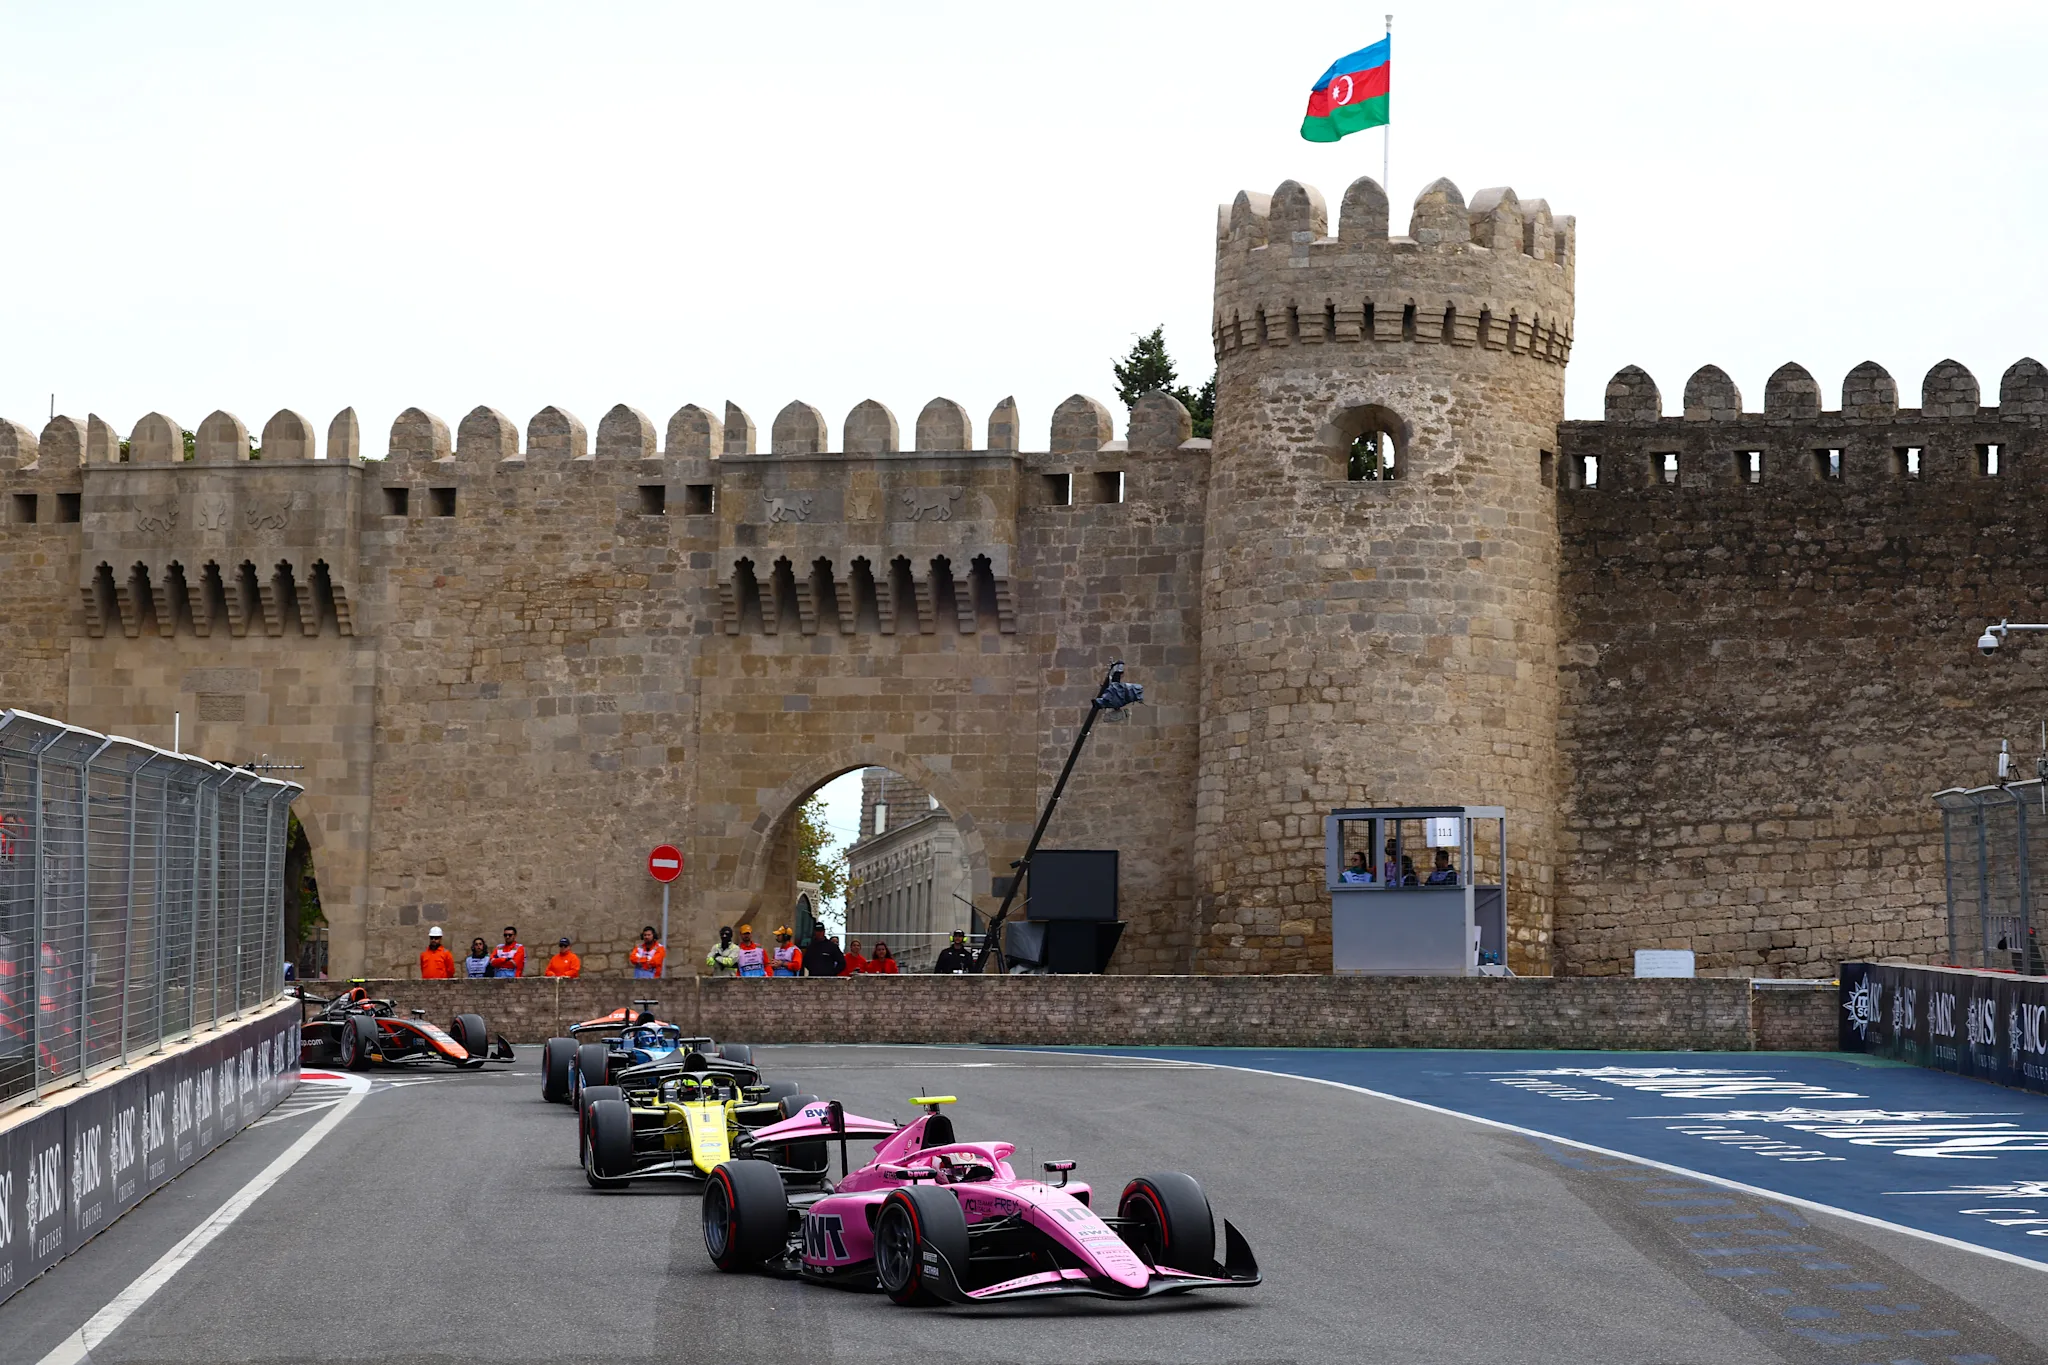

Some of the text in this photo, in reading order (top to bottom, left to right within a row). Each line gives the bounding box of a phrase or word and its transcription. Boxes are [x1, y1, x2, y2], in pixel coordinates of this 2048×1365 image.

[1438, 828, 1452, 836] 11.1
[1935, 992, 1956, 1037] MSC
[2022, 1003, 2047, 1055] MSC
[119, 1106, 135, 1172] MSC
[149, 1091, 165, 1152] MSC
[39, 1142, 61, 1222] MSC
[82, 1124, 101, 1196] MSC
[1053, 1207, 1092, 1222] 10
[39, 1226, 61, 1258] CRUISES
